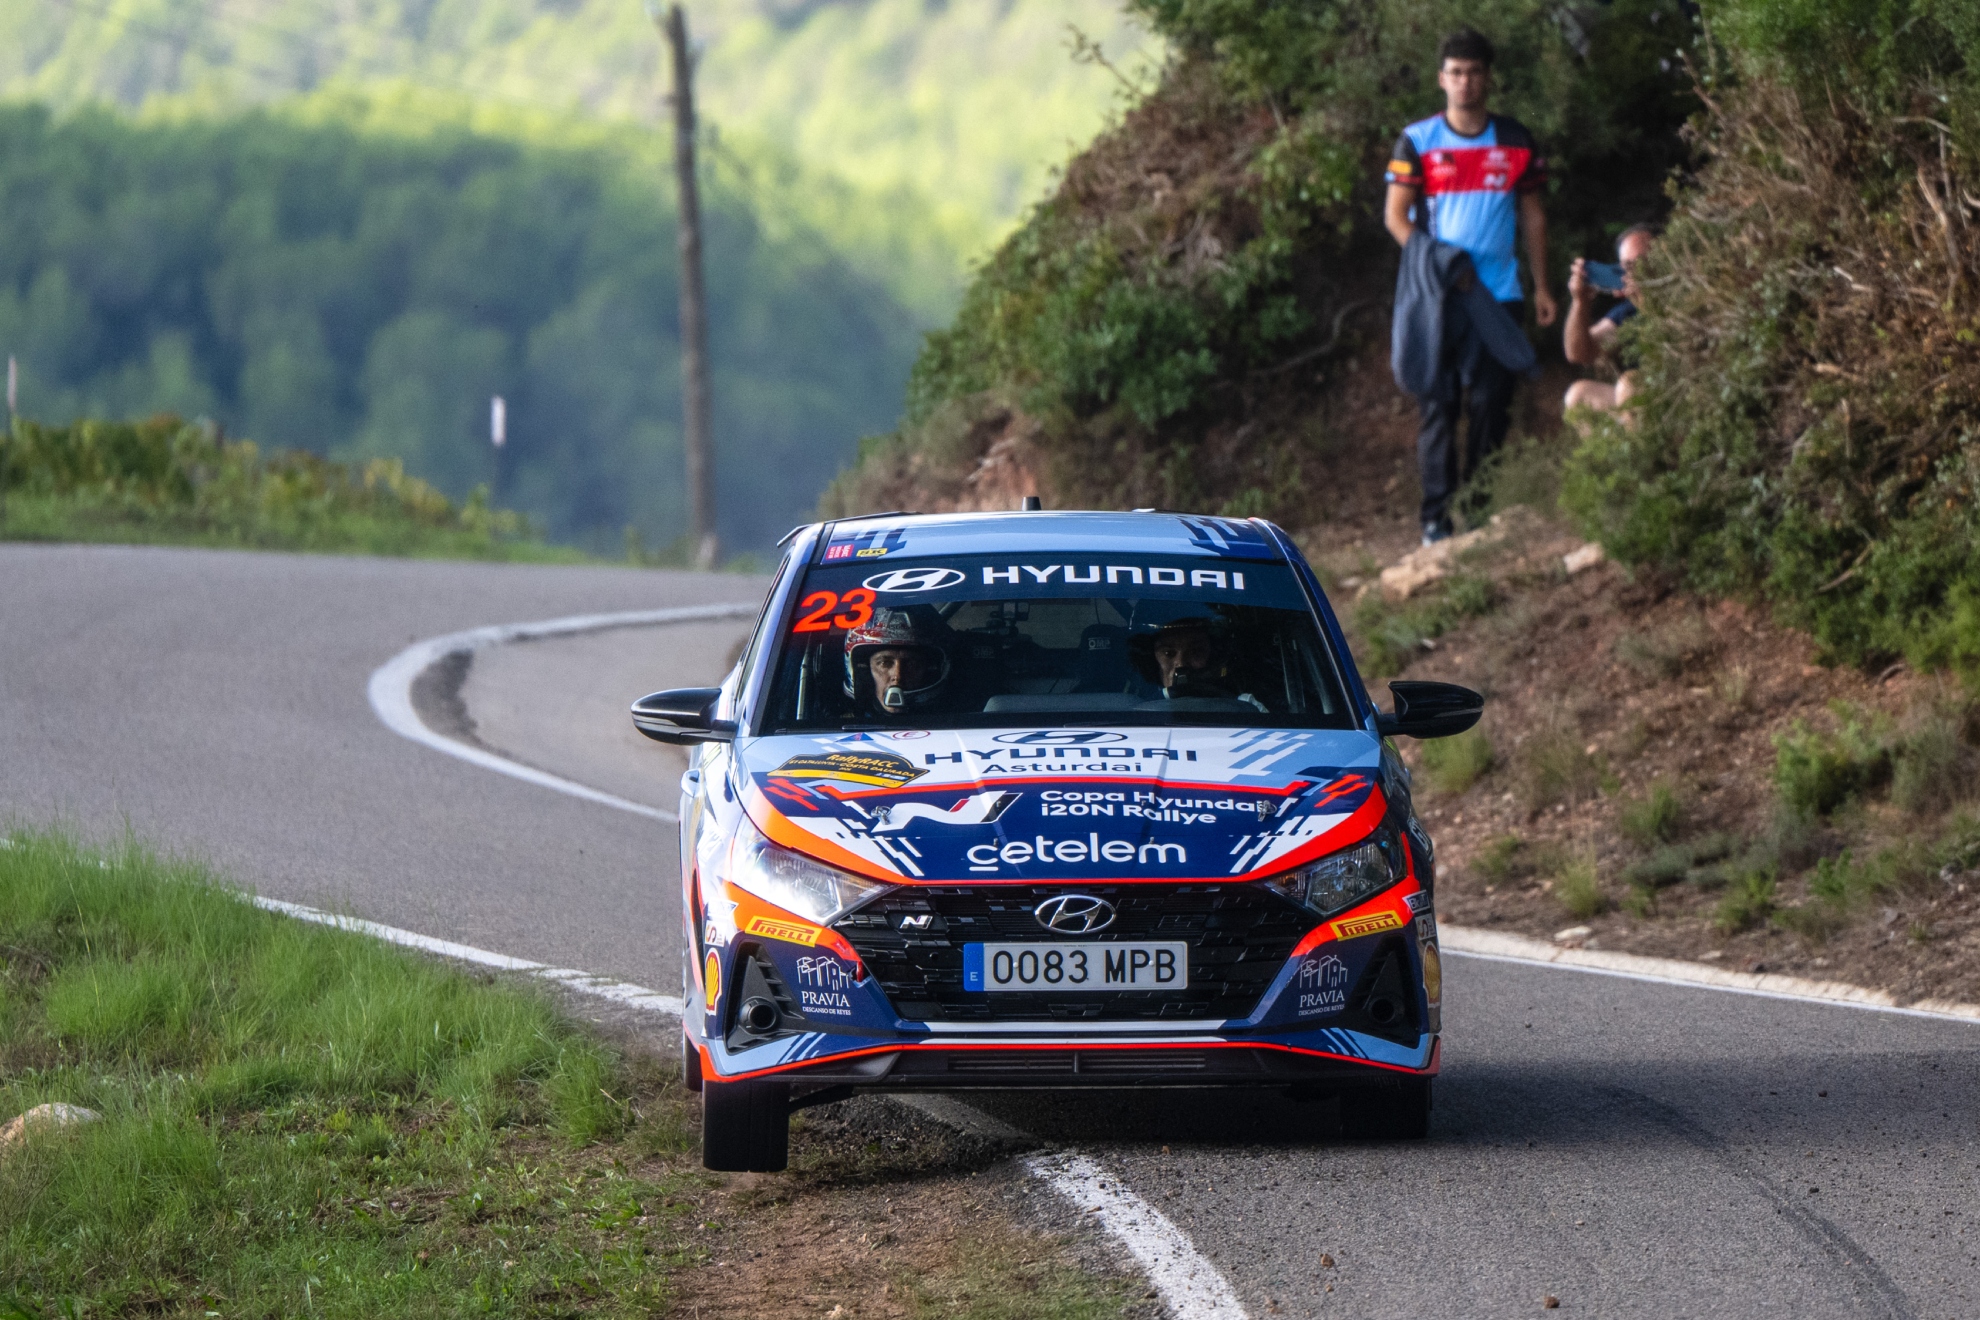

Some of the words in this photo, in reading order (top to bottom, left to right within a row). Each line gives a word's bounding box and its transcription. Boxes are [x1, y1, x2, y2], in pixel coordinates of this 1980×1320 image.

[983, 565, 1245, 590] HYUNDAI
[793, 588, 877, 633] 23
[827, 754, 899, 768] RallyRACC
[925, 747, 1197, 765] HYUNDAI
[870, 767, 915, 777] DAURADA
[982, 762, 1142, 774] Asturdai
[1040, 790, 1125, 803] Copa
[1134, 791, 1262, 812] Hyundai
[1041, 804, 1114, 816] i20N
[1123, 804, 1217, 825] Rallye
[967, 832, 1187, 871] cetelem
[750, 919, 815, 943] PIRELLI
[1337, 913, 1398, 936] PIRELLI
[970, 971, 978, 981] E
[992, 950, 1088, 984] 0083
[1105, 949, 1176, 983] MPB
[802, 990, 850, 1007] PRAVIA
[1300, 989, 1345, 1008] PRAVIA
[802, 1006, 829, 1014] DESCANSO
[837, 1008, 851, 1016] REYES
[1299, 1007, 1323, 1016] DESCANSO
[1331, 1004, 1345, 1012] REYES
